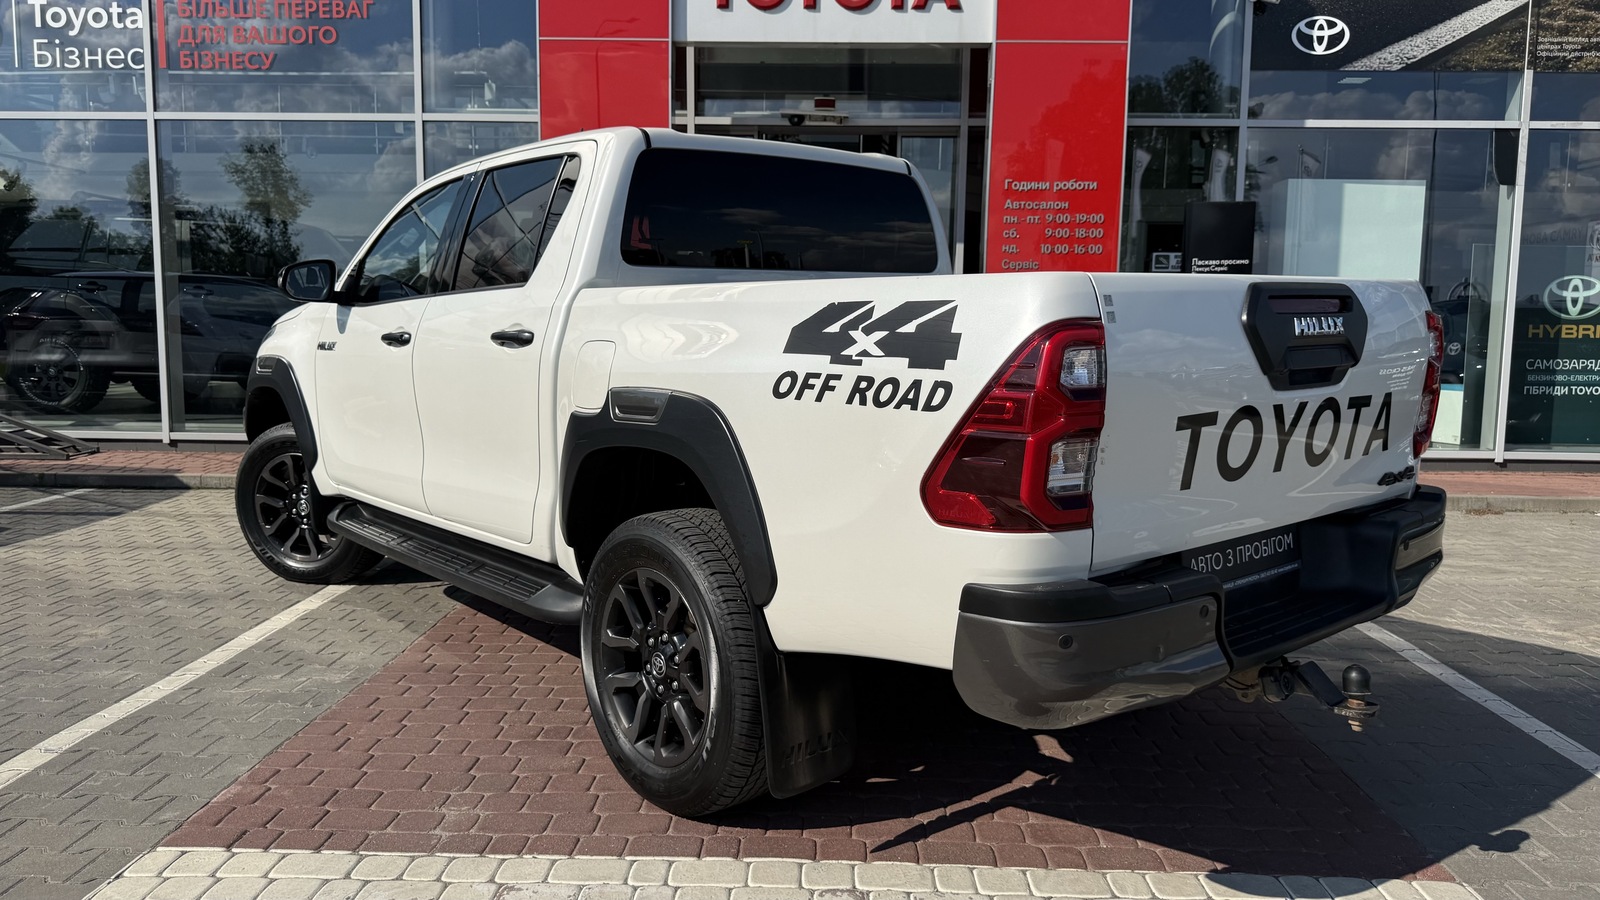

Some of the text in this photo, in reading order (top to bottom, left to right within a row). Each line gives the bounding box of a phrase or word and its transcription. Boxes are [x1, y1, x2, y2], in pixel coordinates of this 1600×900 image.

[28, 0, 143, 36] Toyota
[177, 0, 374, 18] БІЛЬШЕ ПЕРЕВАГ
[178, 25, 337, 47] ДЛЯ ВАШОГО
[33, 39, 144, 69] Бізнес
[179, 51, 276, 69] БІЗНЕСУ
[1004, 179, 1098, 193] Години роботи
[1004, 199, 1069, 210] Автосалон
[1046, 213, 1104, 224] 9:00-19:00
[1003, 228, 1103, 238] сб. 9:00-18:00
[1002, 244, 1103, 254] нд. 10:00-16:00
[1002, 259, 1039, 271] Сервіс
[1192, 258, 1249, 268] Ласкаво просимо
[1294, 317, 1344, 336] HILUX
[772, 370, 954, 413] OFF ROAD
[1523, 386, 1568, 396] ГІБРИДИ
[1175, 391, 1393, 491] TOYOTA
[1190, 552, 1223, 573] АВТО
[1236, 532, 1294, 564] ПРОБІГОМ
